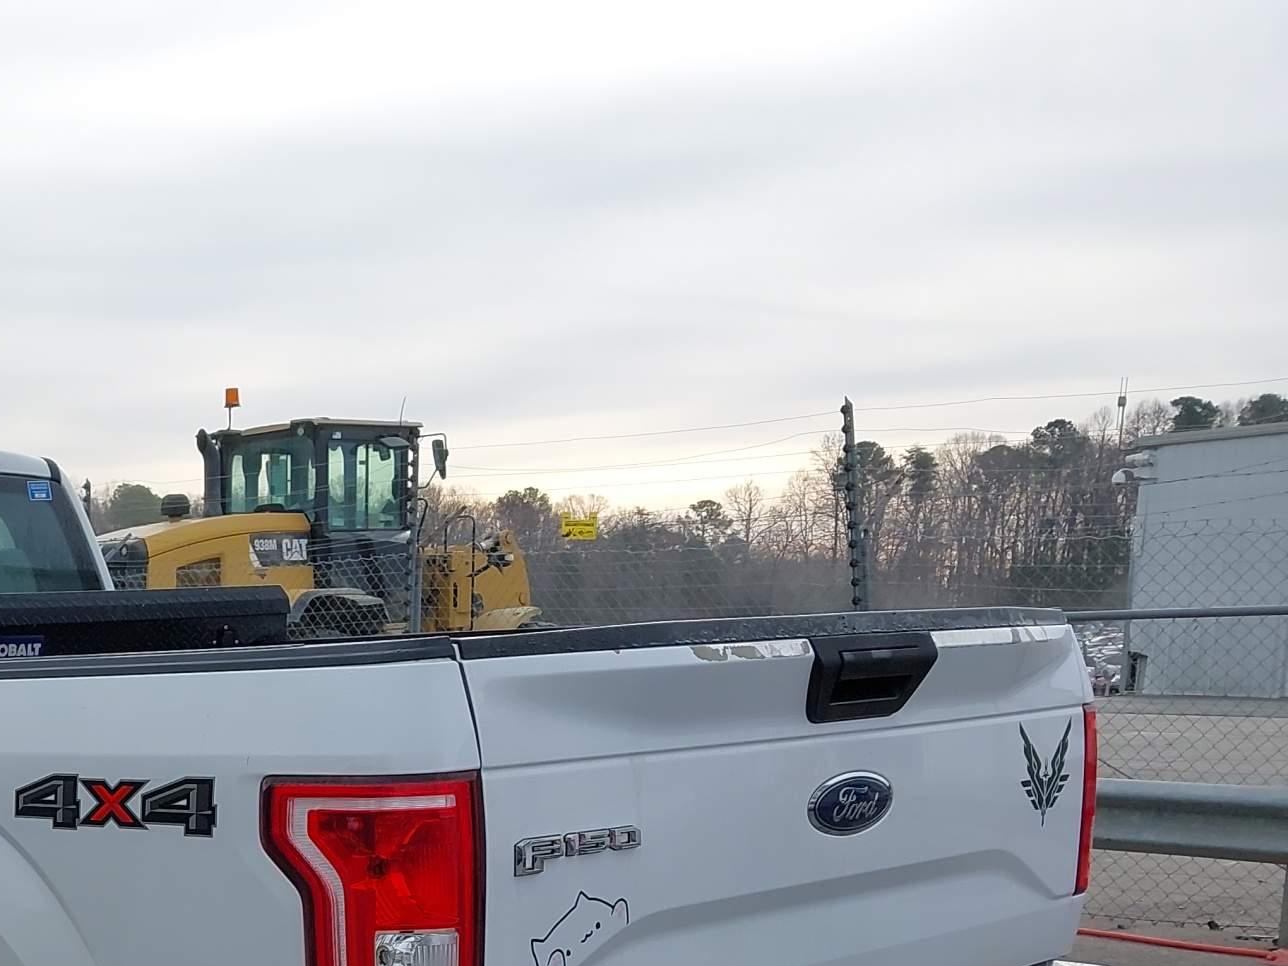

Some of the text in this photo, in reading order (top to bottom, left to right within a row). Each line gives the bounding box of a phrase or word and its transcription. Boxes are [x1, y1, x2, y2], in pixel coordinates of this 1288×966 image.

[254, 539, 277, 551] 938M
[282, 539, 308, 561] CAT
[833, 786, 879, 822] Ford
[514, 825, 641, 877] F150
